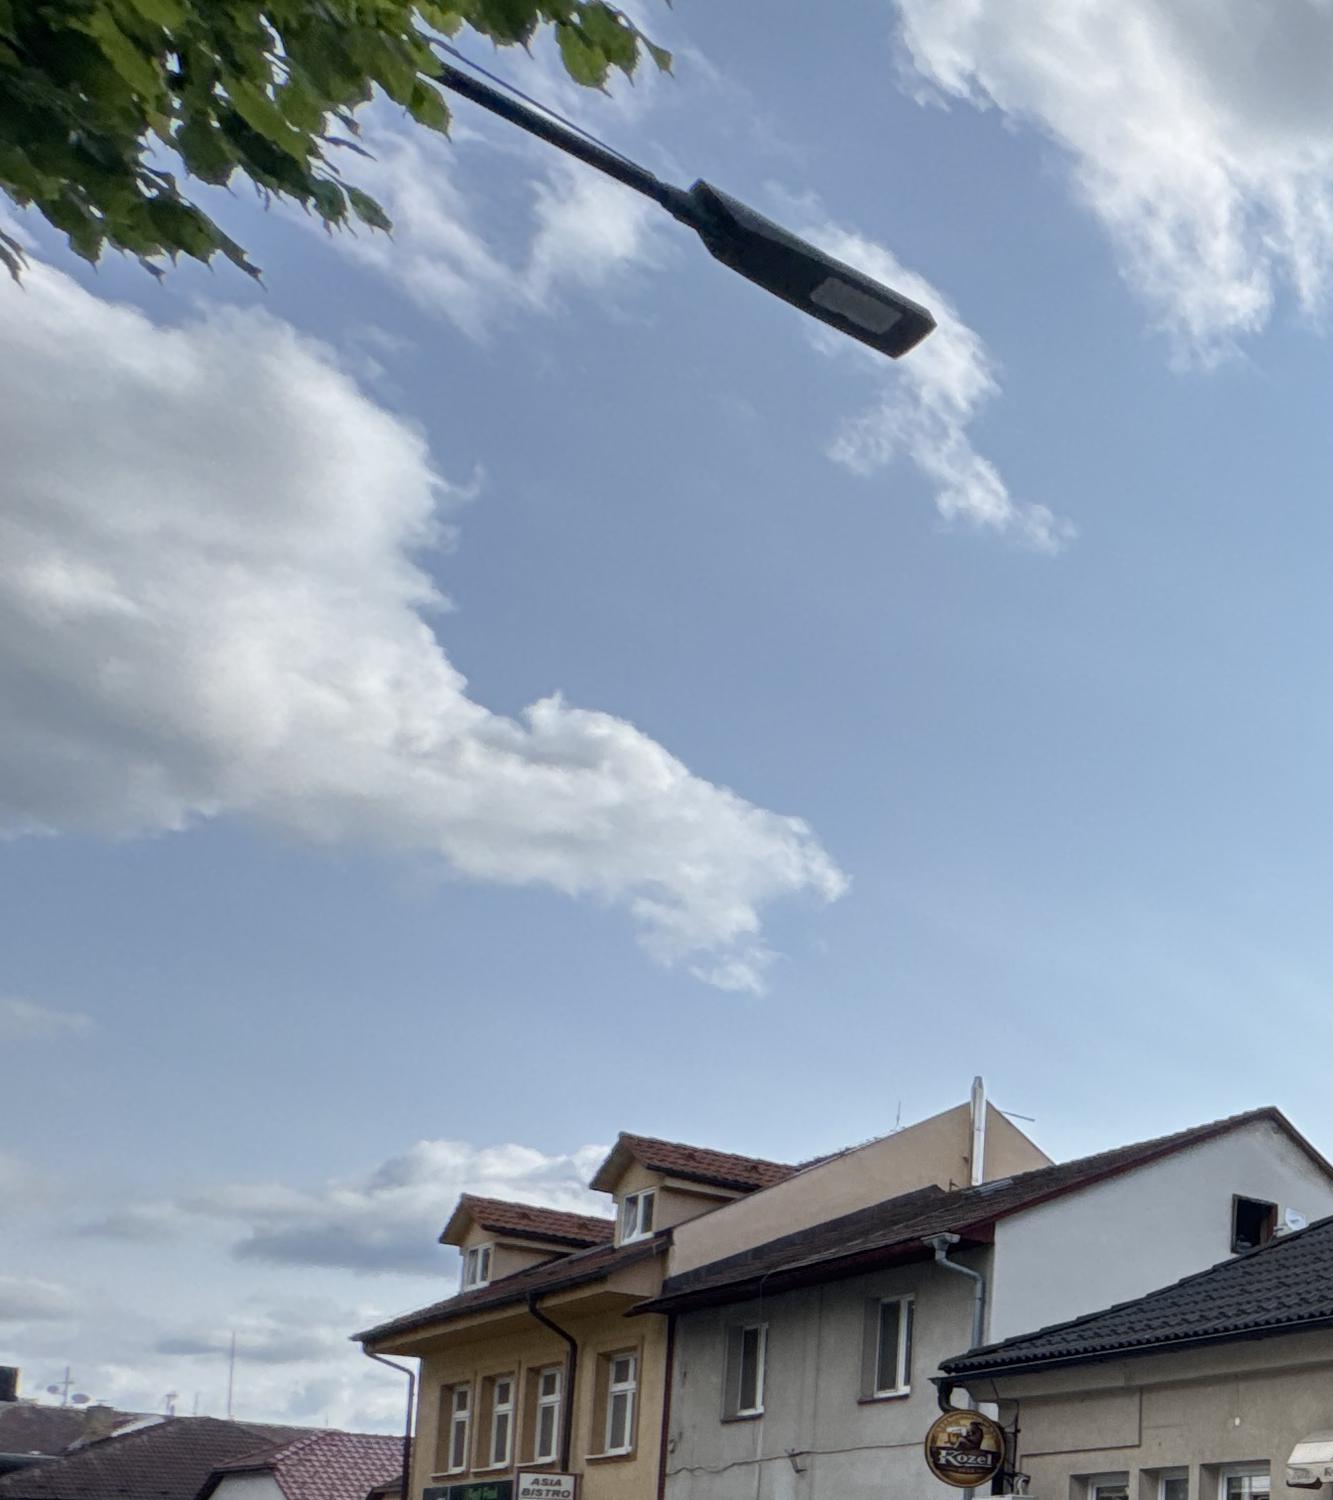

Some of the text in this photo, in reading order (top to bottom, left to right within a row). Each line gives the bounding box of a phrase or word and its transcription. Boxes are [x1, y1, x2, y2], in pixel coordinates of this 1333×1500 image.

[938, 1450, 993, 1467] Kozel
[530, 1478, 562, 1487] ASIA
[521, 1488, 571, 1499] BISTRO
